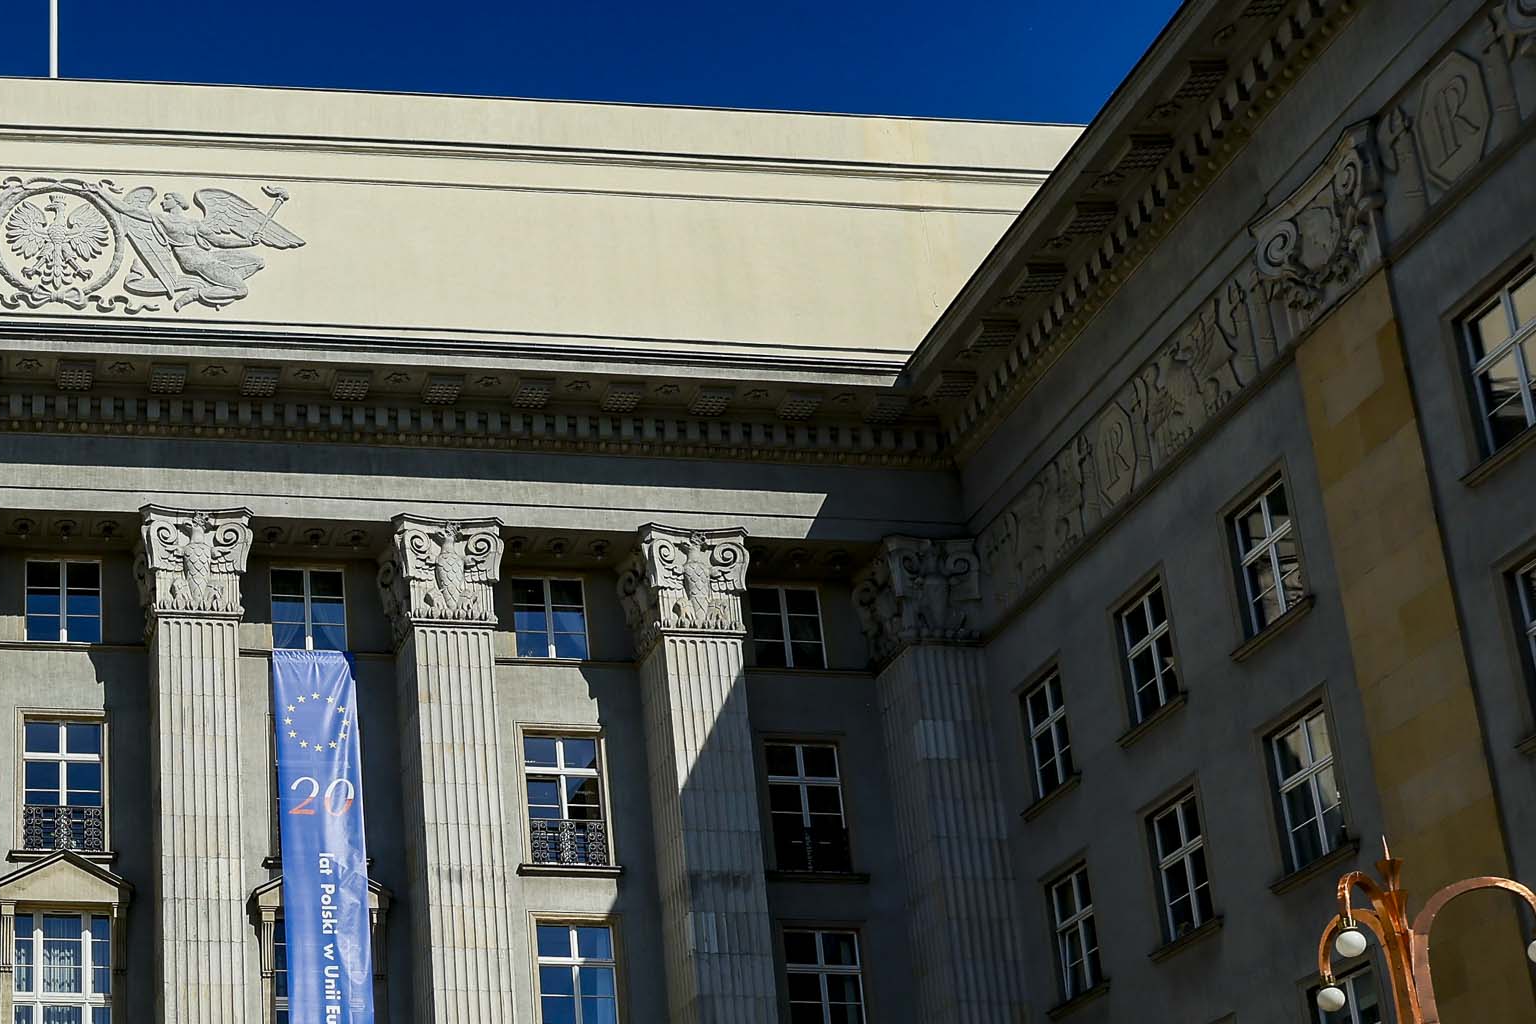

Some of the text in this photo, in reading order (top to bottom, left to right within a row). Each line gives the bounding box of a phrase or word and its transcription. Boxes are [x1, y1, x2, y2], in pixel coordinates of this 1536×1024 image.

[288, 776, 355, 816] 20
[319, 852, 334, 875] lat
[320, 884, 339, 935] Polski
[323, 943, 334, 961] w
[324, 966, 341, 1000] Unii
